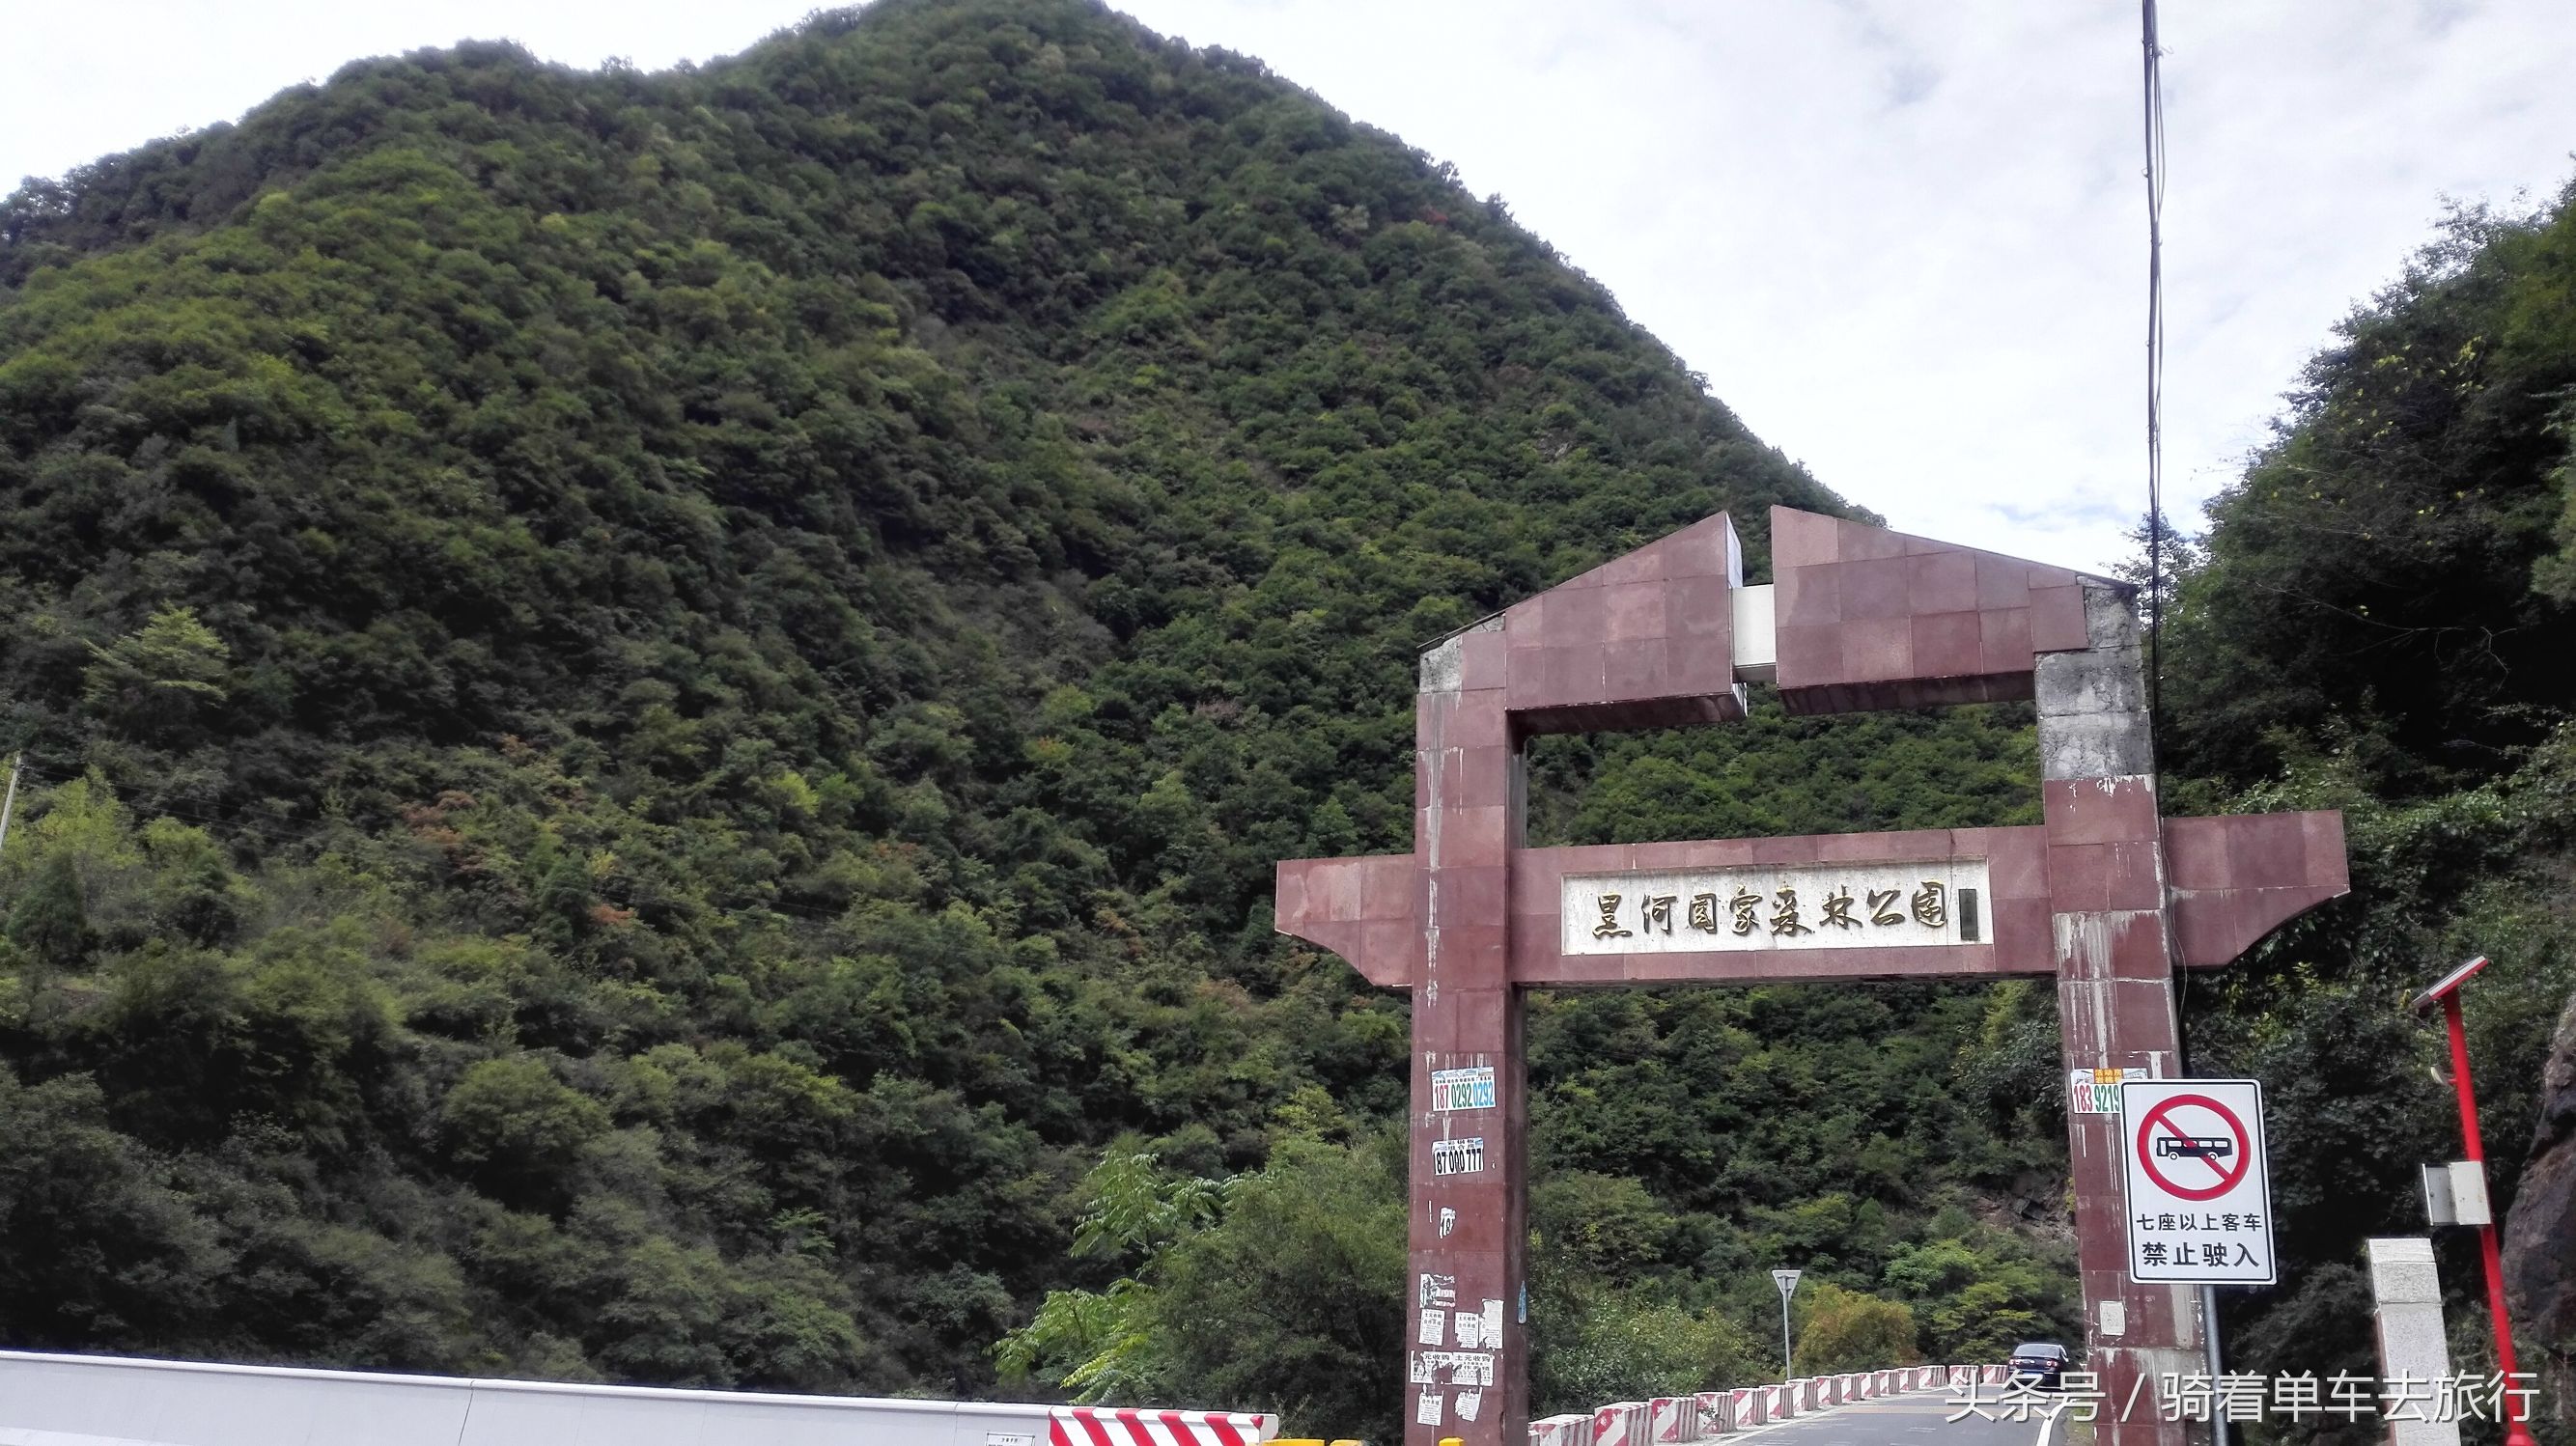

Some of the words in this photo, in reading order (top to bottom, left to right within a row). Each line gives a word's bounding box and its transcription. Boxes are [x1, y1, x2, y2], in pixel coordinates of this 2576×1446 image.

[2073, 1084, 2092, 1112] 183
[2094, 1084, 2119, 1112] 9219
[2136, 1212, 2262, 1232] 七座以上客车
[2142, 1241, 2259, 1267] 禁止驶入
